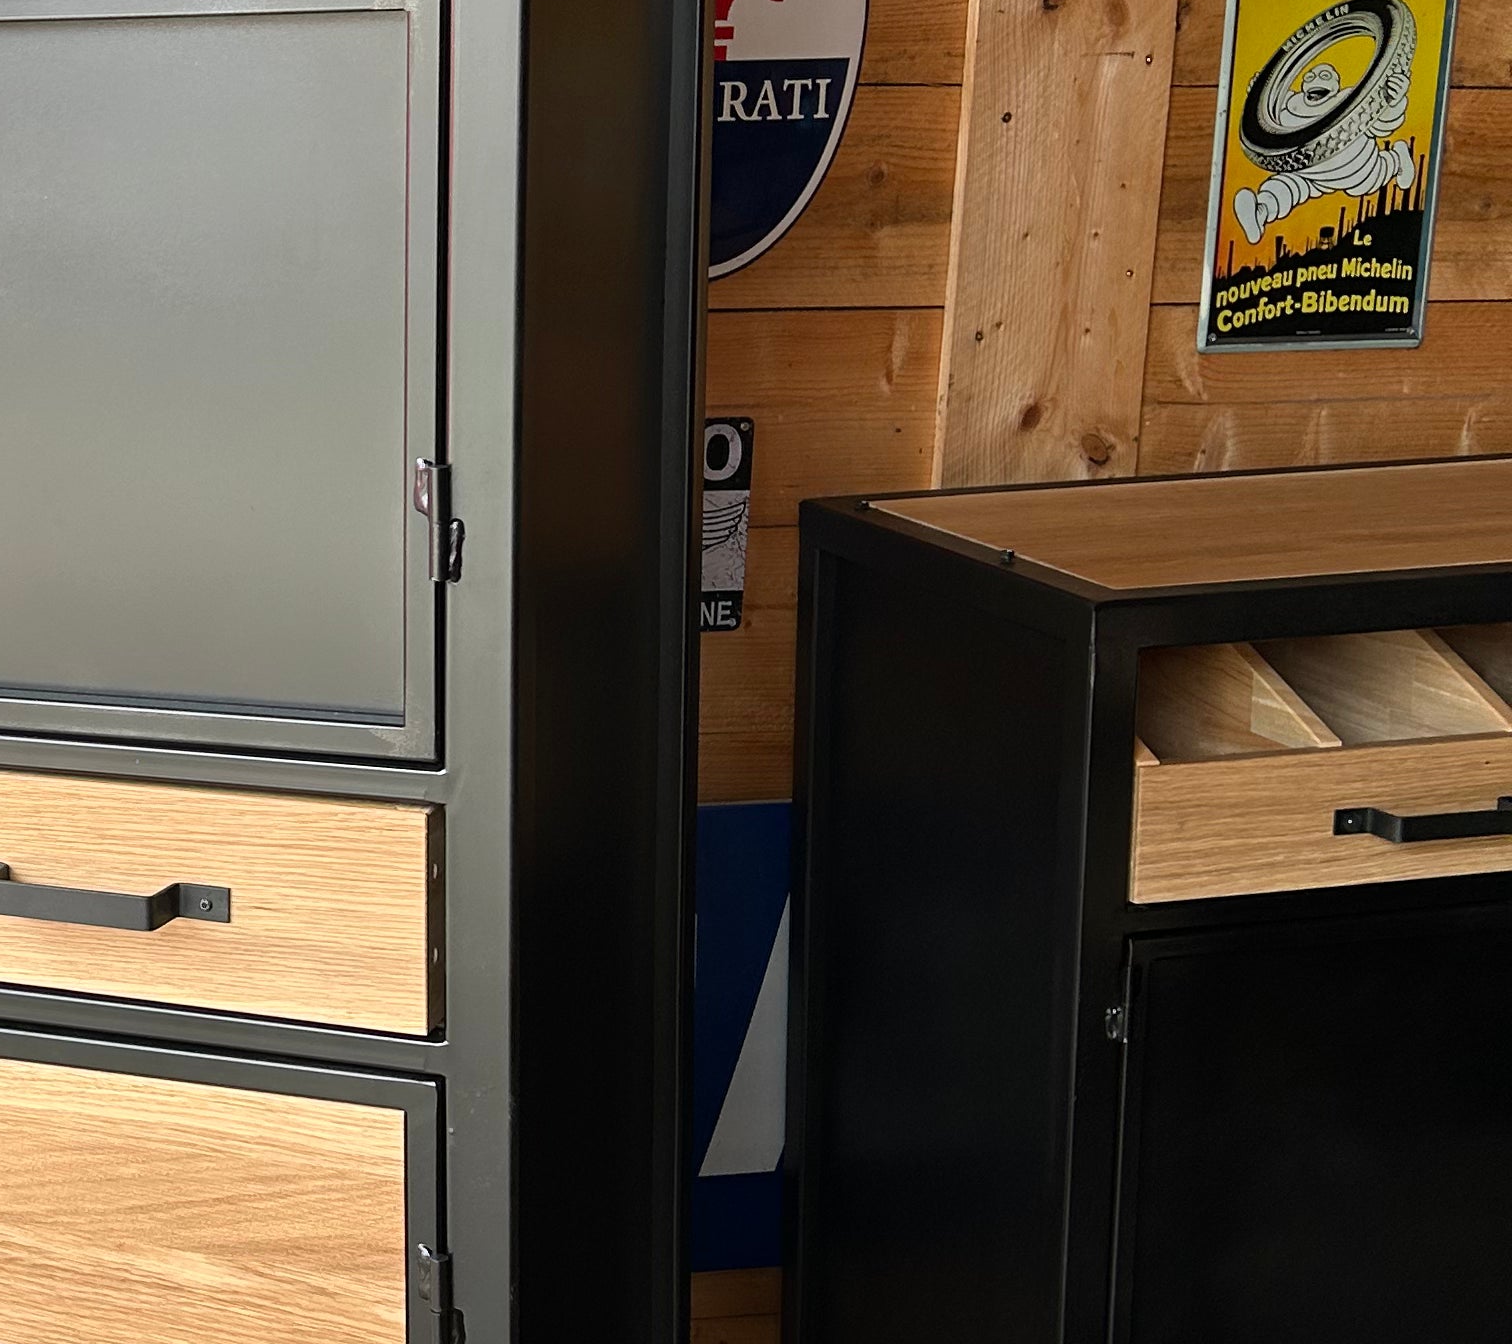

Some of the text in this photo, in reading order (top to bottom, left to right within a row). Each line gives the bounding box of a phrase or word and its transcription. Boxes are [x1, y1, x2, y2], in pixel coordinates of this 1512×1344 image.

[1281, 3, 1349, 52] MICHELIN
[1353, 229, 1373, 246] Le
[1216, 256, 1413, 308] nouveau pneu Michelin
[1216, 289, 1409, 332] Confort-Bibendum
